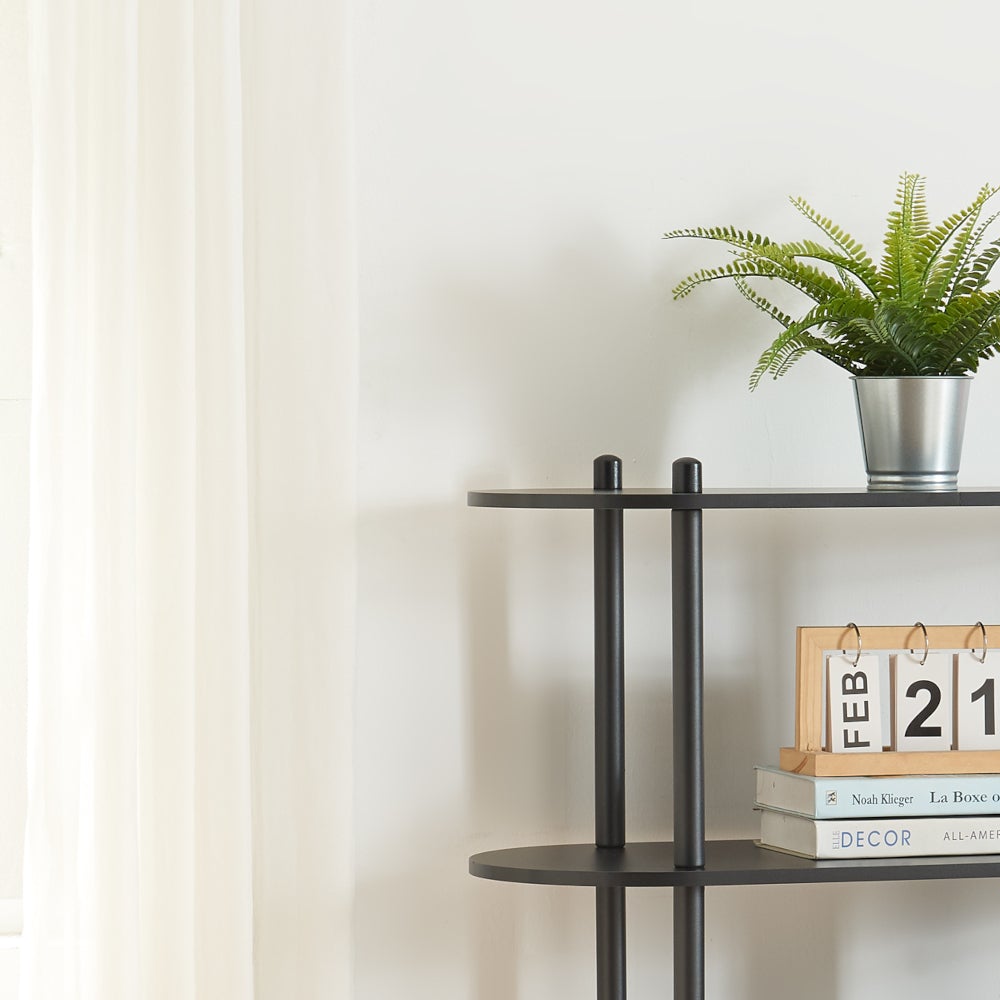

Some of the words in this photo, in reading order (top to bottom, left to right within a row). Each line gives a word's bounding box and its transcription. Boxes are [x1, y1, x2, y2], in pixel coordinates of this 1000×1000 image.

[842, 671, 870, 748] FEB
[904, 680, 942, 737] 2
[971, 678, 995, 735] 1
[851, 794, 878, 806] Noah
[881, 793, 914, 807] Klieger
[929, 791, 948, 804] La
[953, 790, 988, 803] Boxe
[841, 829, 911, 848] DECOR
